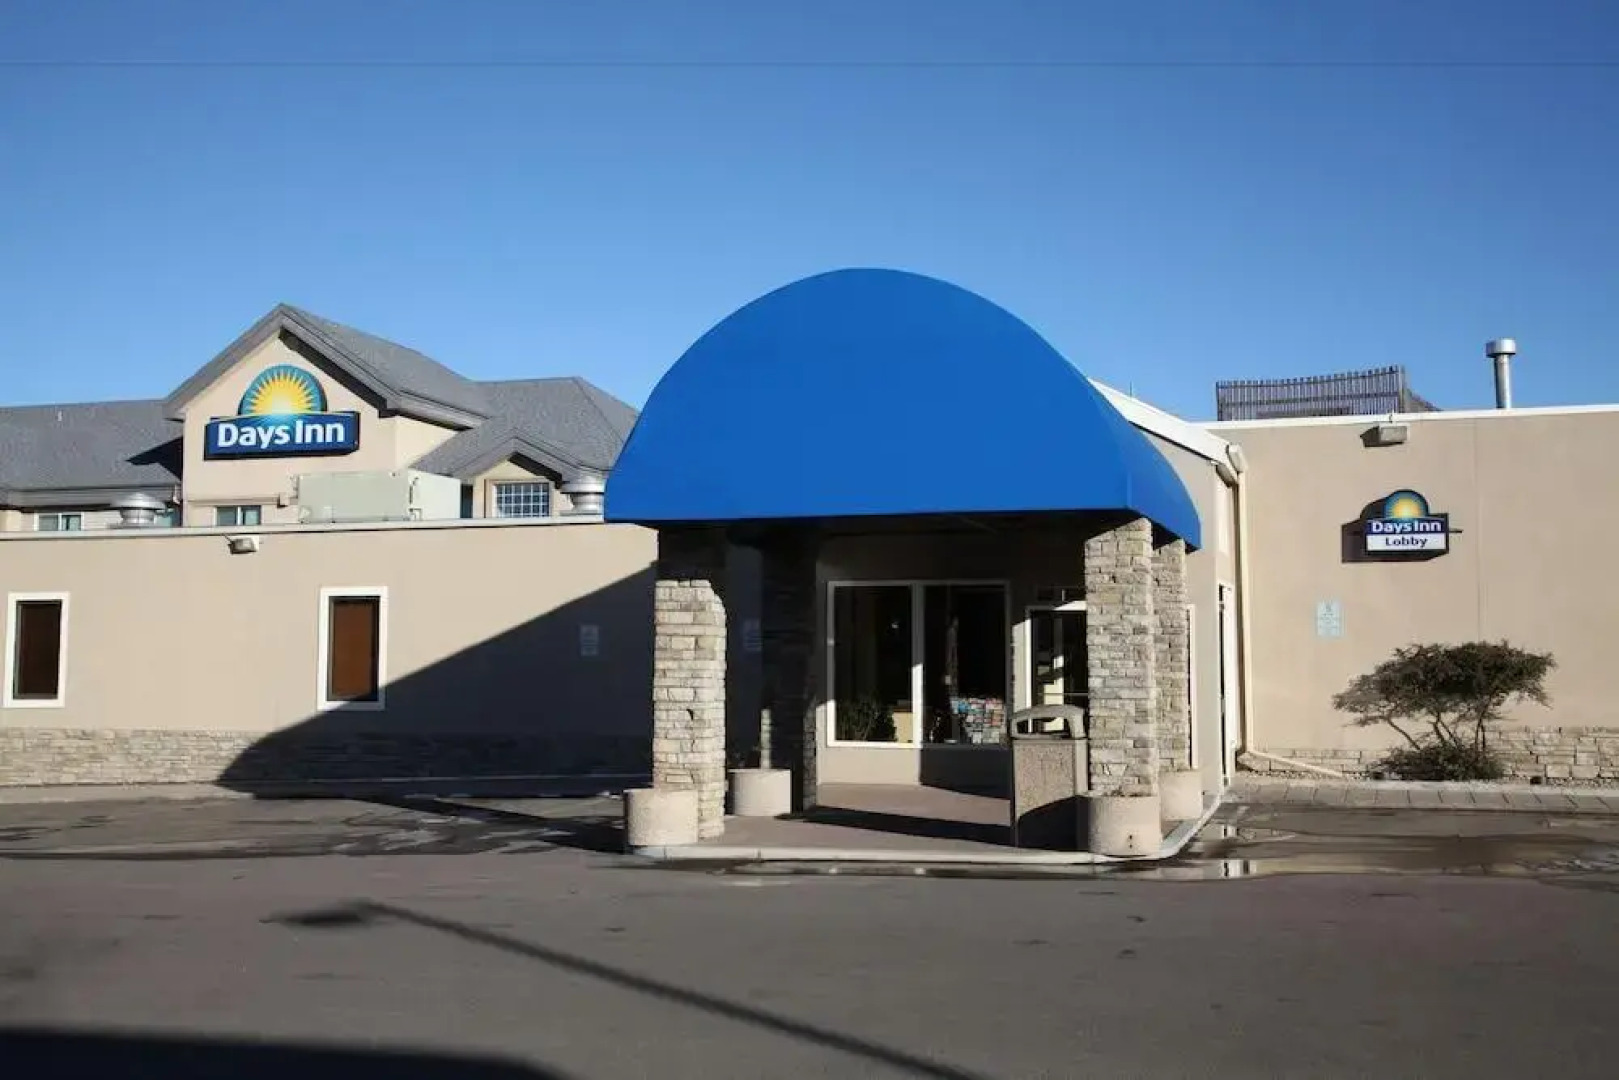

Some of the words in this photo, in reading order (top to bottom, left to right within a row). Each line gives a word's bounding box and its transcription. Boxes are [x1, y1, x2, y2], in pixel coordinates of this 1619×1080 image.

[217, 422, 290, 449] Days
[295, 420, 345, 444] Inn
[1372, 521, 1412, 534] Days
[1414, 520, 1442, 532] Inn
[1385, 536, 1428, 548] Lobby
